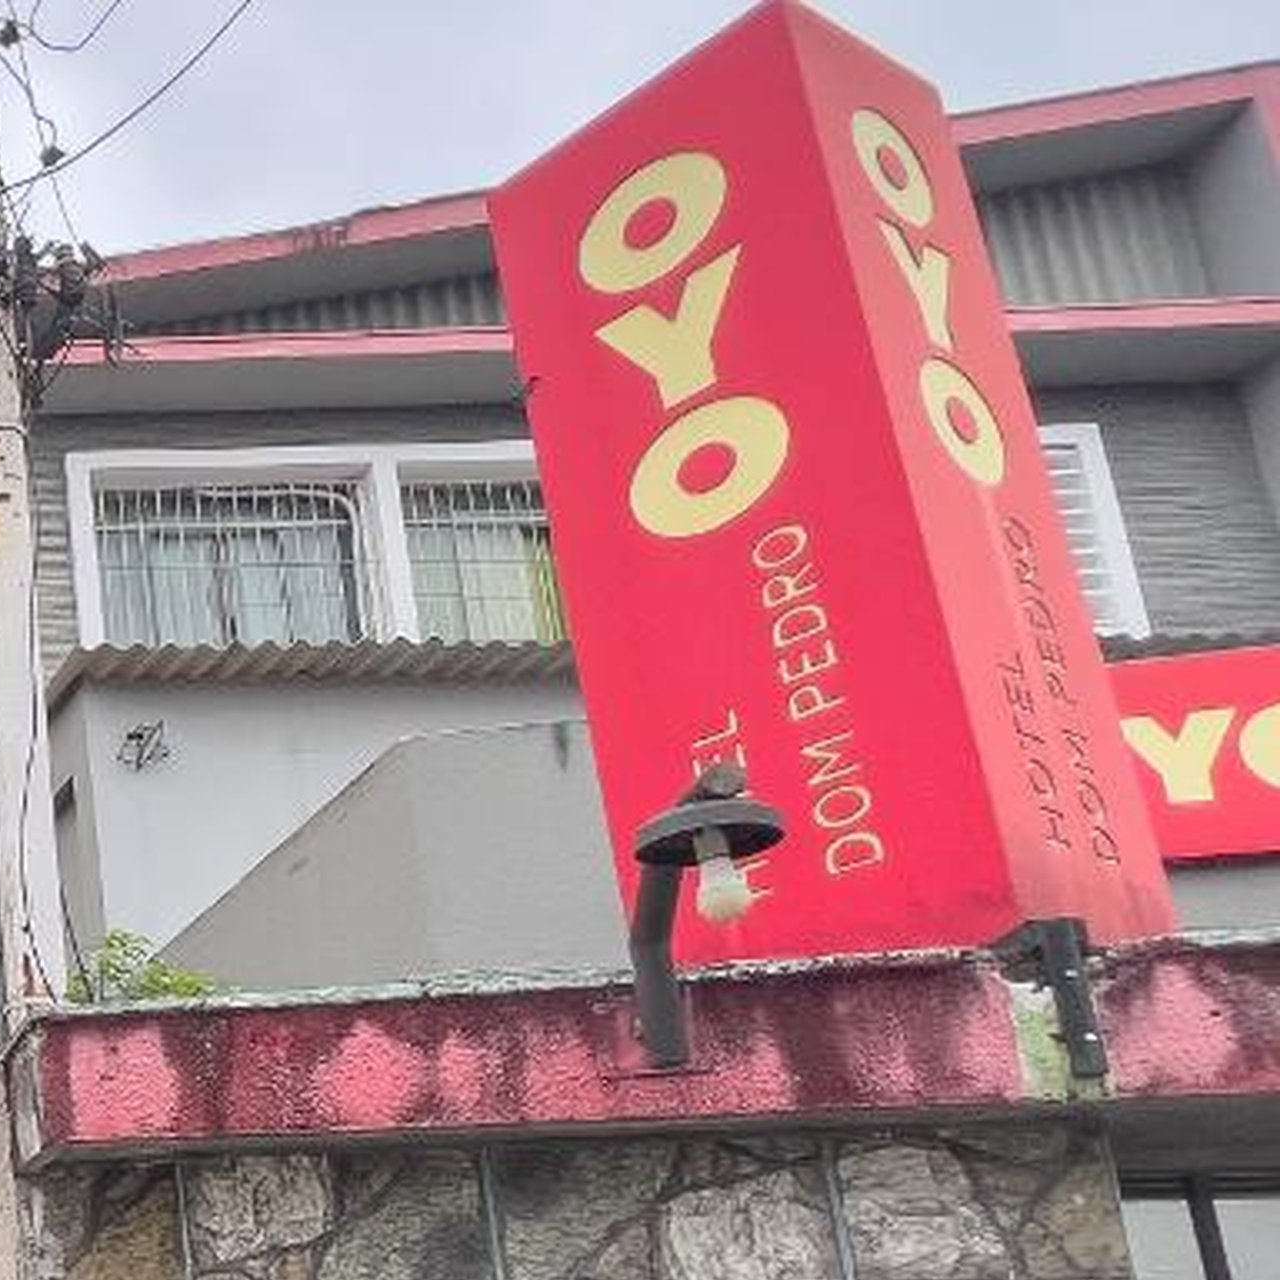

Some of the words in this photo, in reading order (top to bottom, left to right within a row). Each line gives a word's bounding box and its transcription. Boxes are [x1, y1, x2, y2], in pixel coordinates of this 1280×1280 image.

[579, 152, 790, 538] OYO
[851, 107, 1004, 486] OYO
[752, 524, 847, 722] PEDRO
[1003, 515, 1077, 707] PEDRO
[800, 728, 885, 876] DOM
[997, 651, 1072, 849] HOTEL
[1062, 727, 1122, 866] DOM
